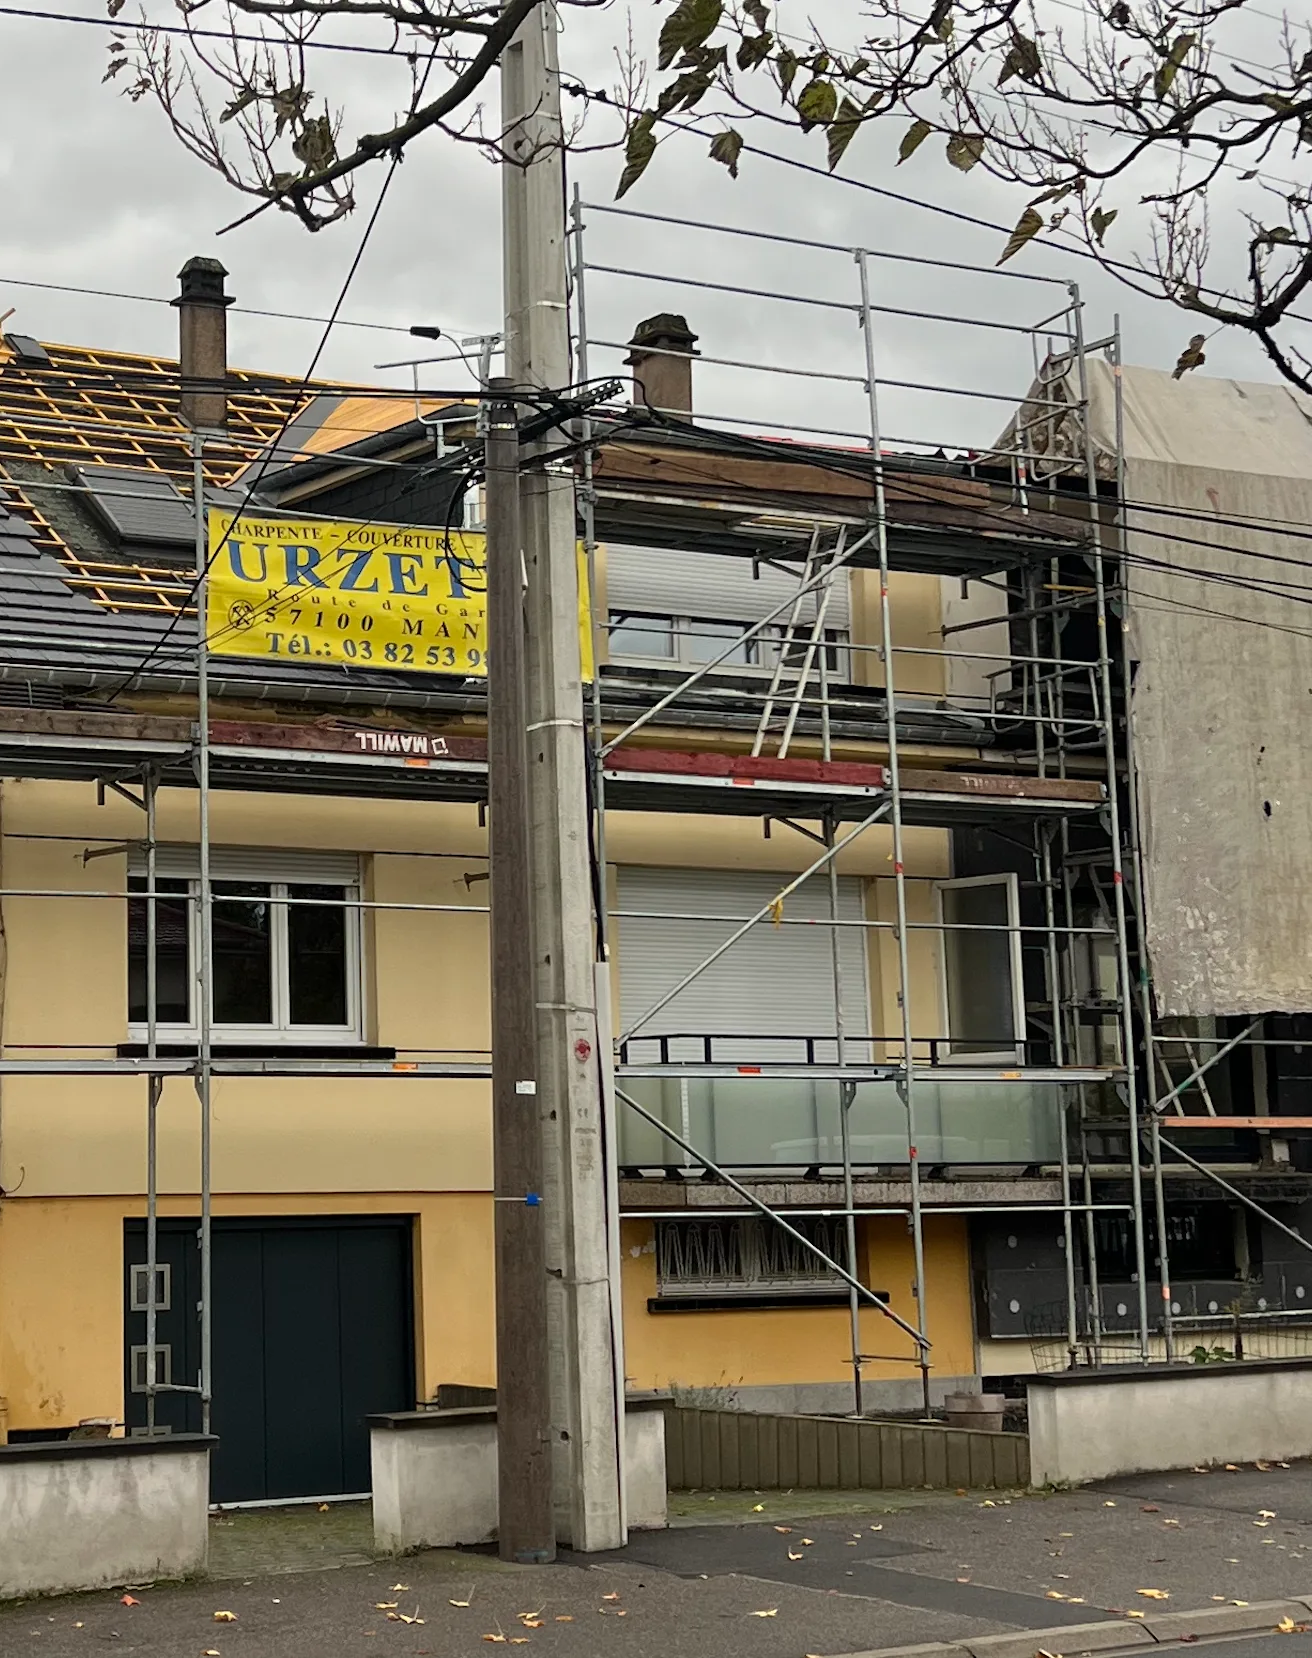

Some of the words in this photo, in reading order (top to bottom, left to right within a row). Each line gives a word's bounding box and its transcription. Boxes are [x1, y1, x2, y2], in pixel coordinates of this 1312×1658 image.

[221, 518, 323, 540] CHARPENTE
[347, 529, 457, 552] COUVERTURE
[227, 538, 487, 600] URZET
[267, 588, 357, 608] Route
[382, 600, 410, 613] de
[435, 603, 486, 618] Gar
[265, 606, 374, 632] 57100
[401, 618, 480, 640] MAN
[342, 638, 373, 660] 03
[384, 642, 414, 664] 82
[425, 645, 456, 667] 53
[354, 732, 428, 754] MAWILL
